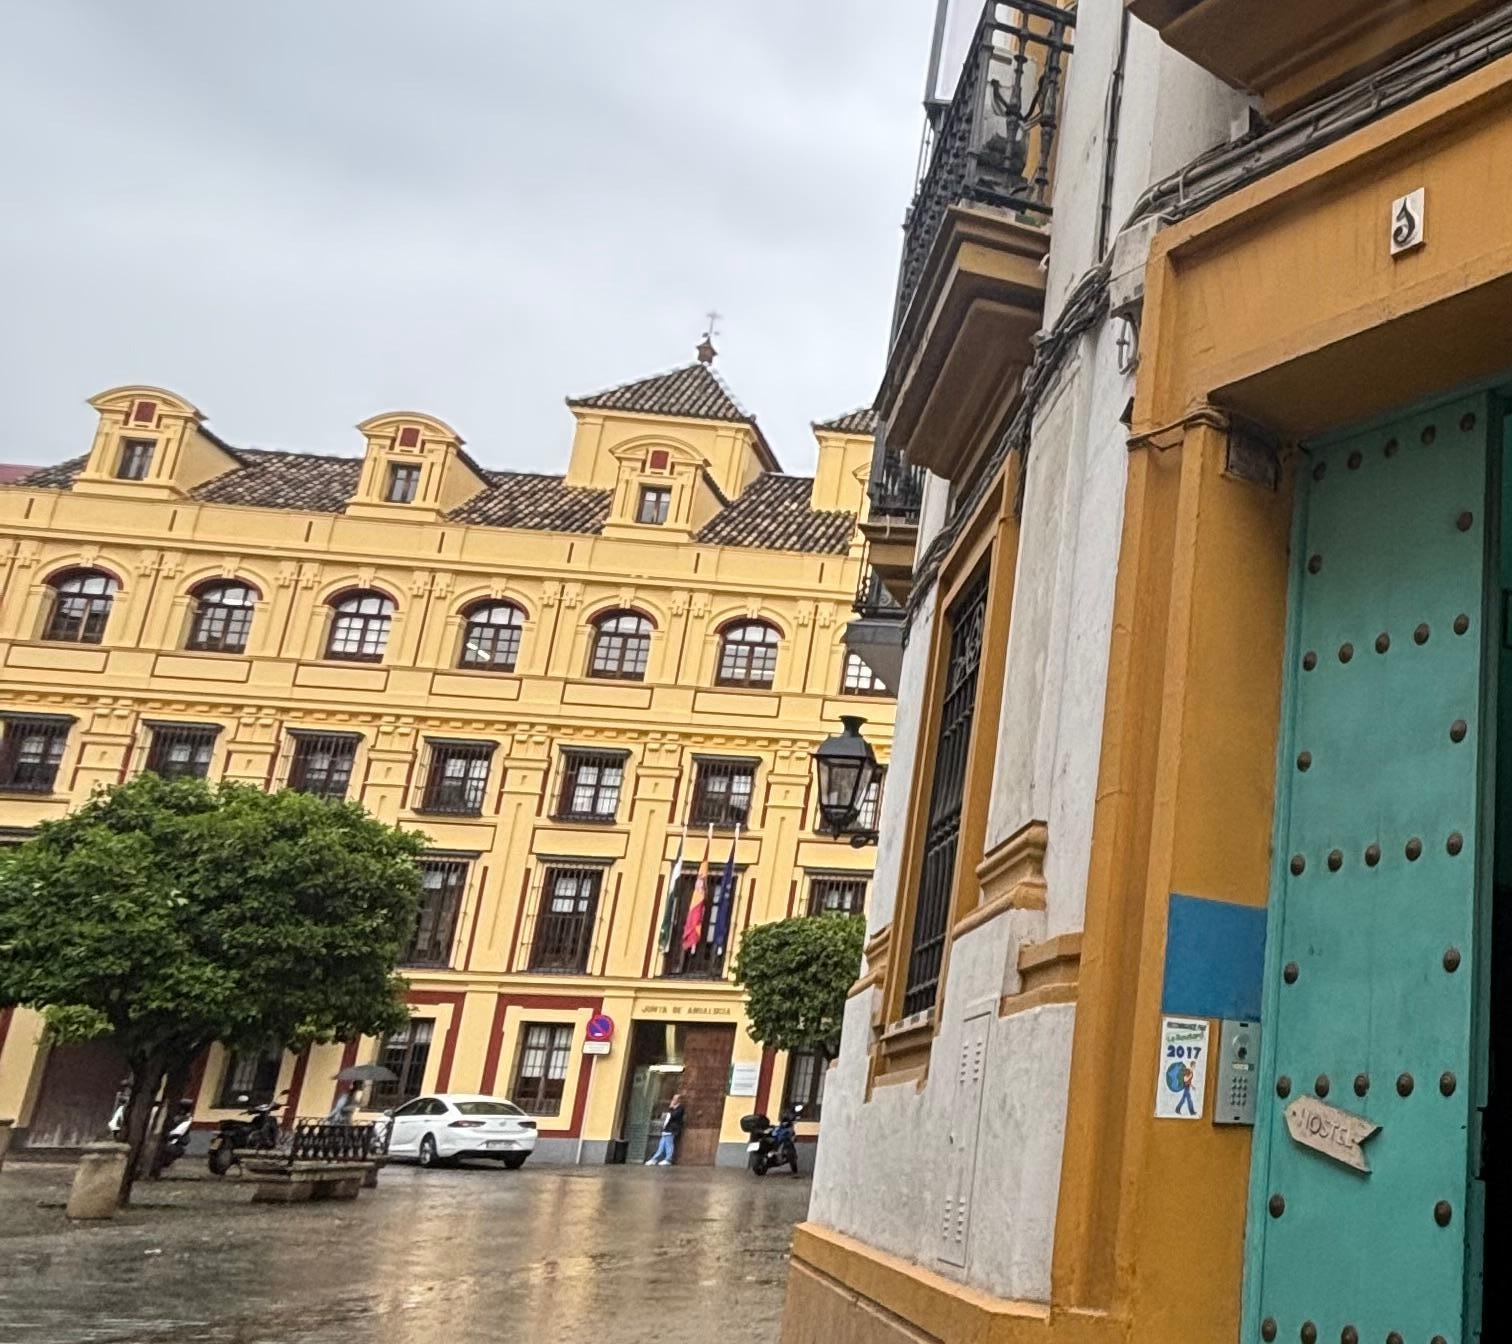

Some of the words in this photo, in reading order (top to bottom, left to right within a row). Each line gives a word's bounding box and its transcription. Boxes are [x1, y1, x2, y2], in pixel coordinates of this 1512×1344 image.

[672, 1006, 681, 1014] DE
[1167, 1045, 1201, 1060] 2017
[1297, 1108, 1355, 1150] HOSTEL
